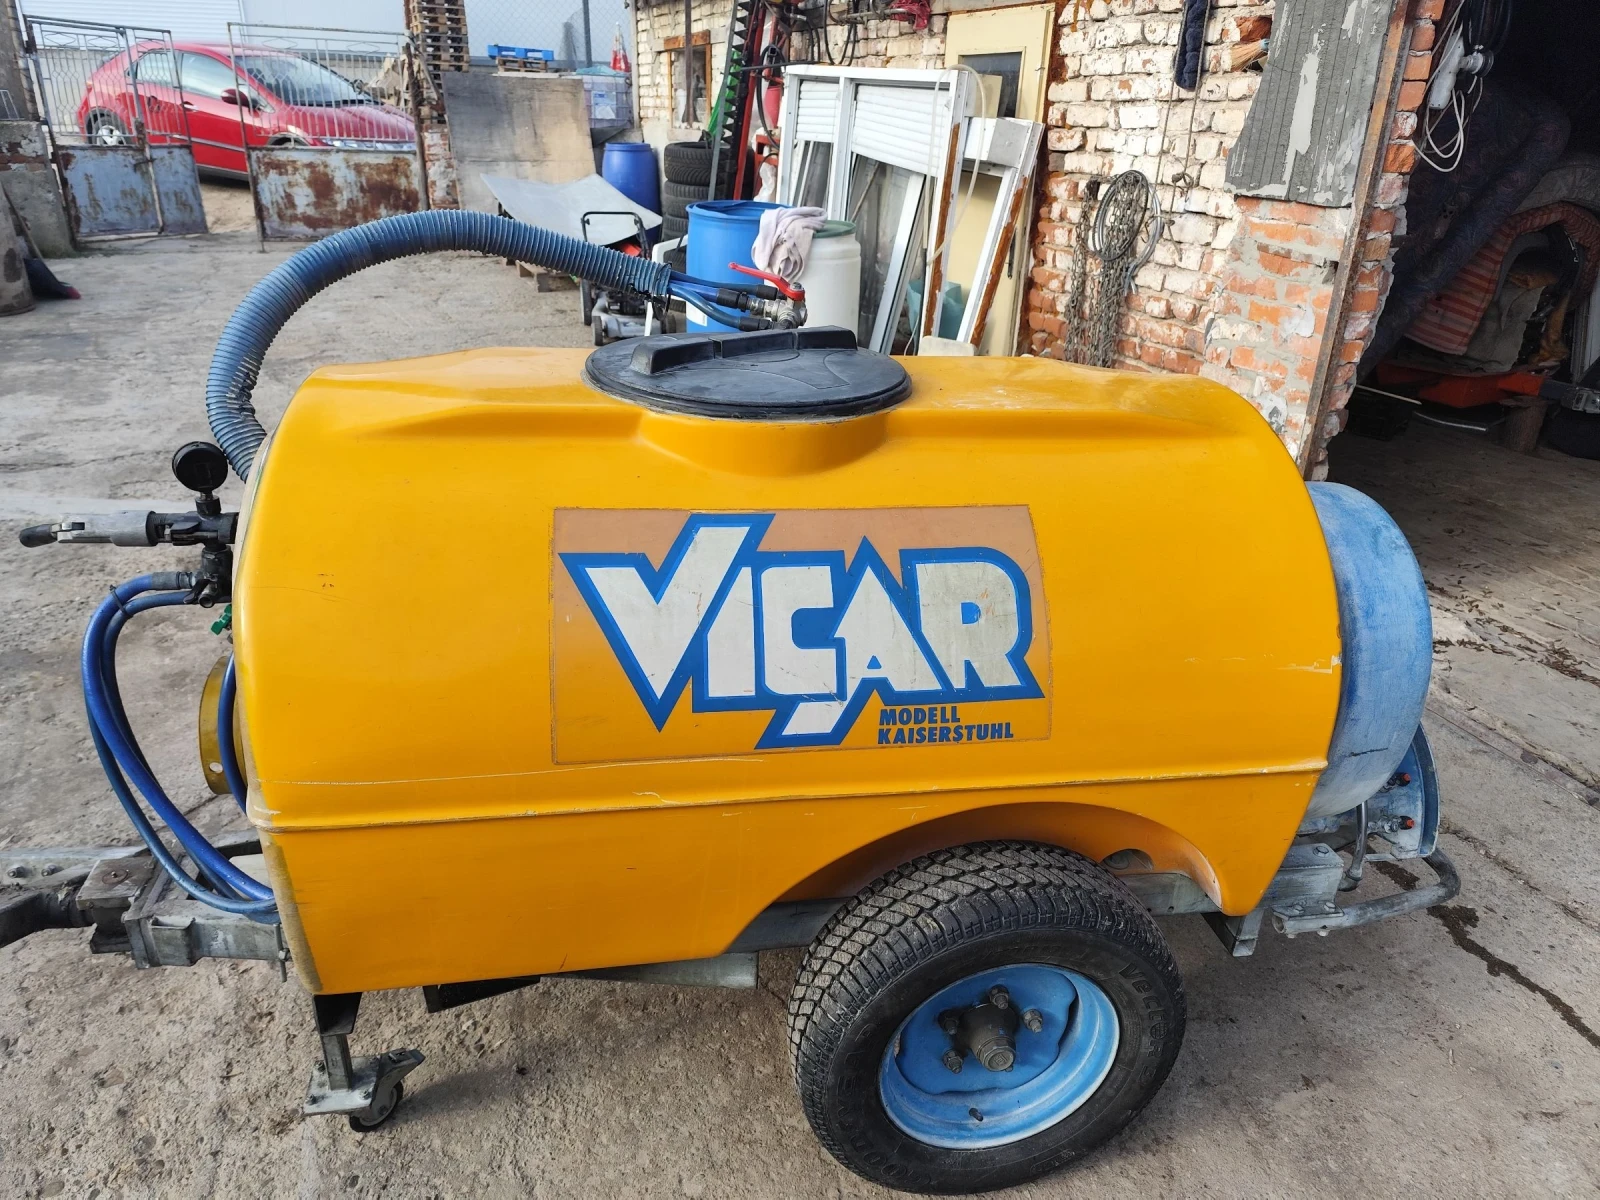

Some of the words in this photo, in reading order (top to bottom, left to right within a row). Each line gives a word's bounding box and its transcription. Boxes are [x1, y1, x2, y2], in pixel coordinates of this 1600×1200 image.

[558, 513, 1045, 749] VICAR
[879, 706, 960, 726] MODELL
[877, 722, 1014, 745] KAISERSTUHL
